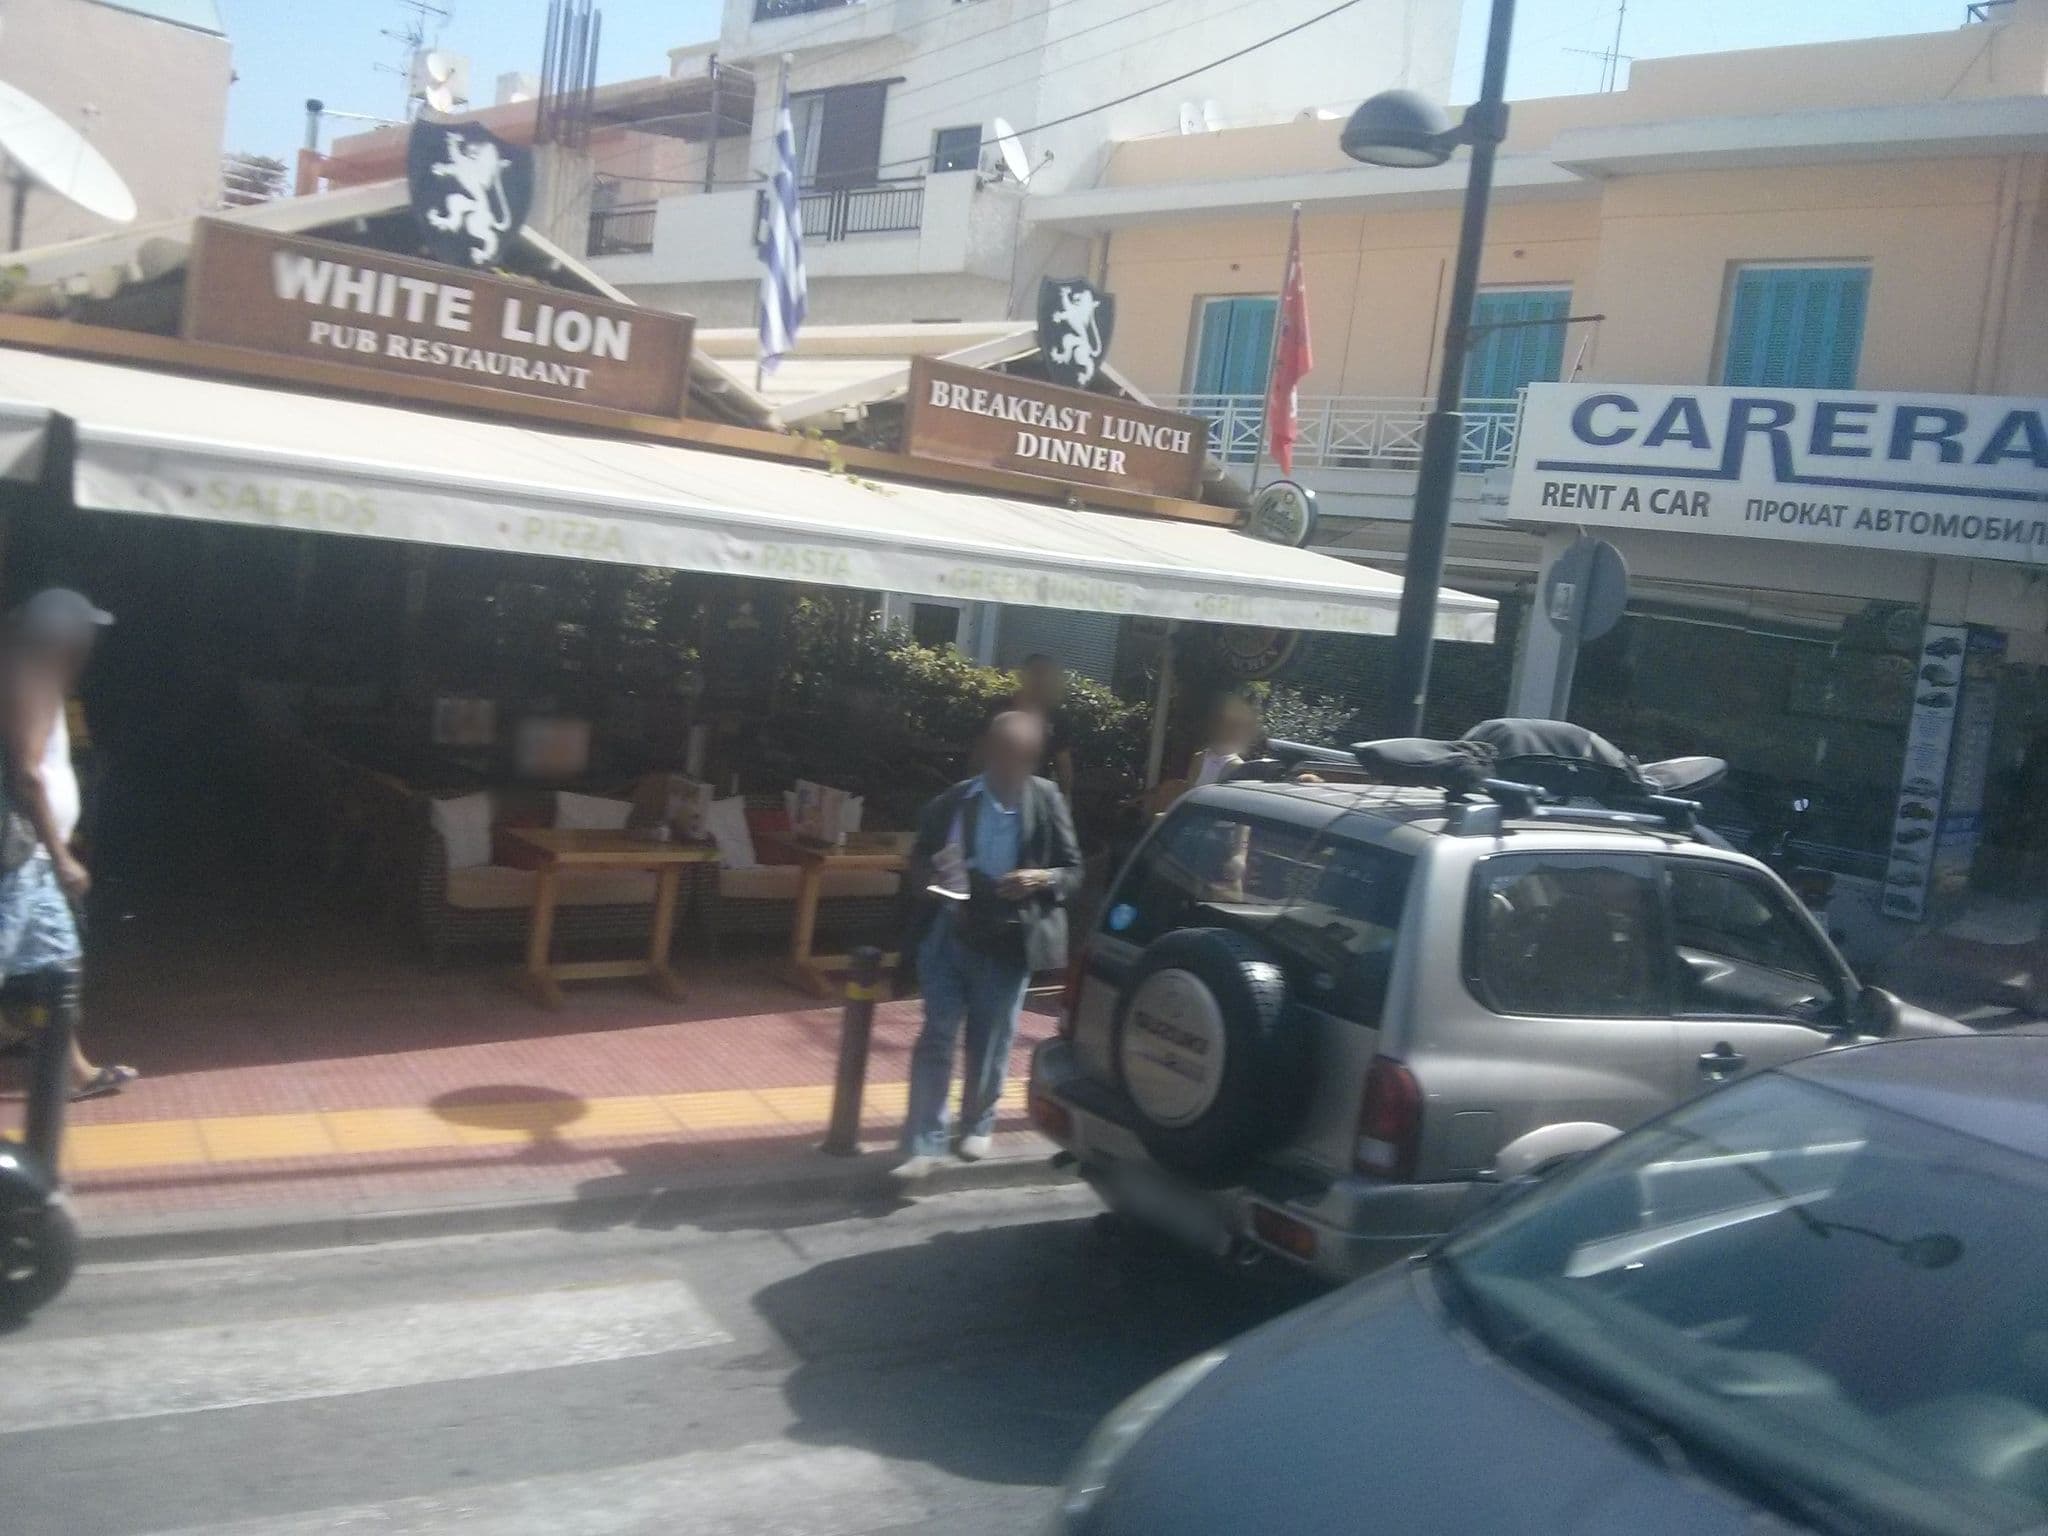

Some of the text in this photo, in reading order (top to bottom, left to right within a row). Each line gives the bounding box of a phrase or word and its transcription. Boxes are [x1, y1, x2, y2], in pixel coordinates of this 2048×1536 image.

[273, 250, 632, 361] WHITE LION
[308, 320, 593, 390] PUB RESTAURANT
[929, 379, 1192, 454] BREAKFAST LUNCH
[1570, 392, 2048, 482] CARERA
[1015, 431, 1127, 475] DINNER
[205, 477, 378, 530] SALADS
[523, 516, 626, 553] PIZZA
[760, 544, 851, 577] PASTA
[1541, 481, 1711, 518] RENT A CAR
[1744, 498, 1849, 529] ПРОКАТ
